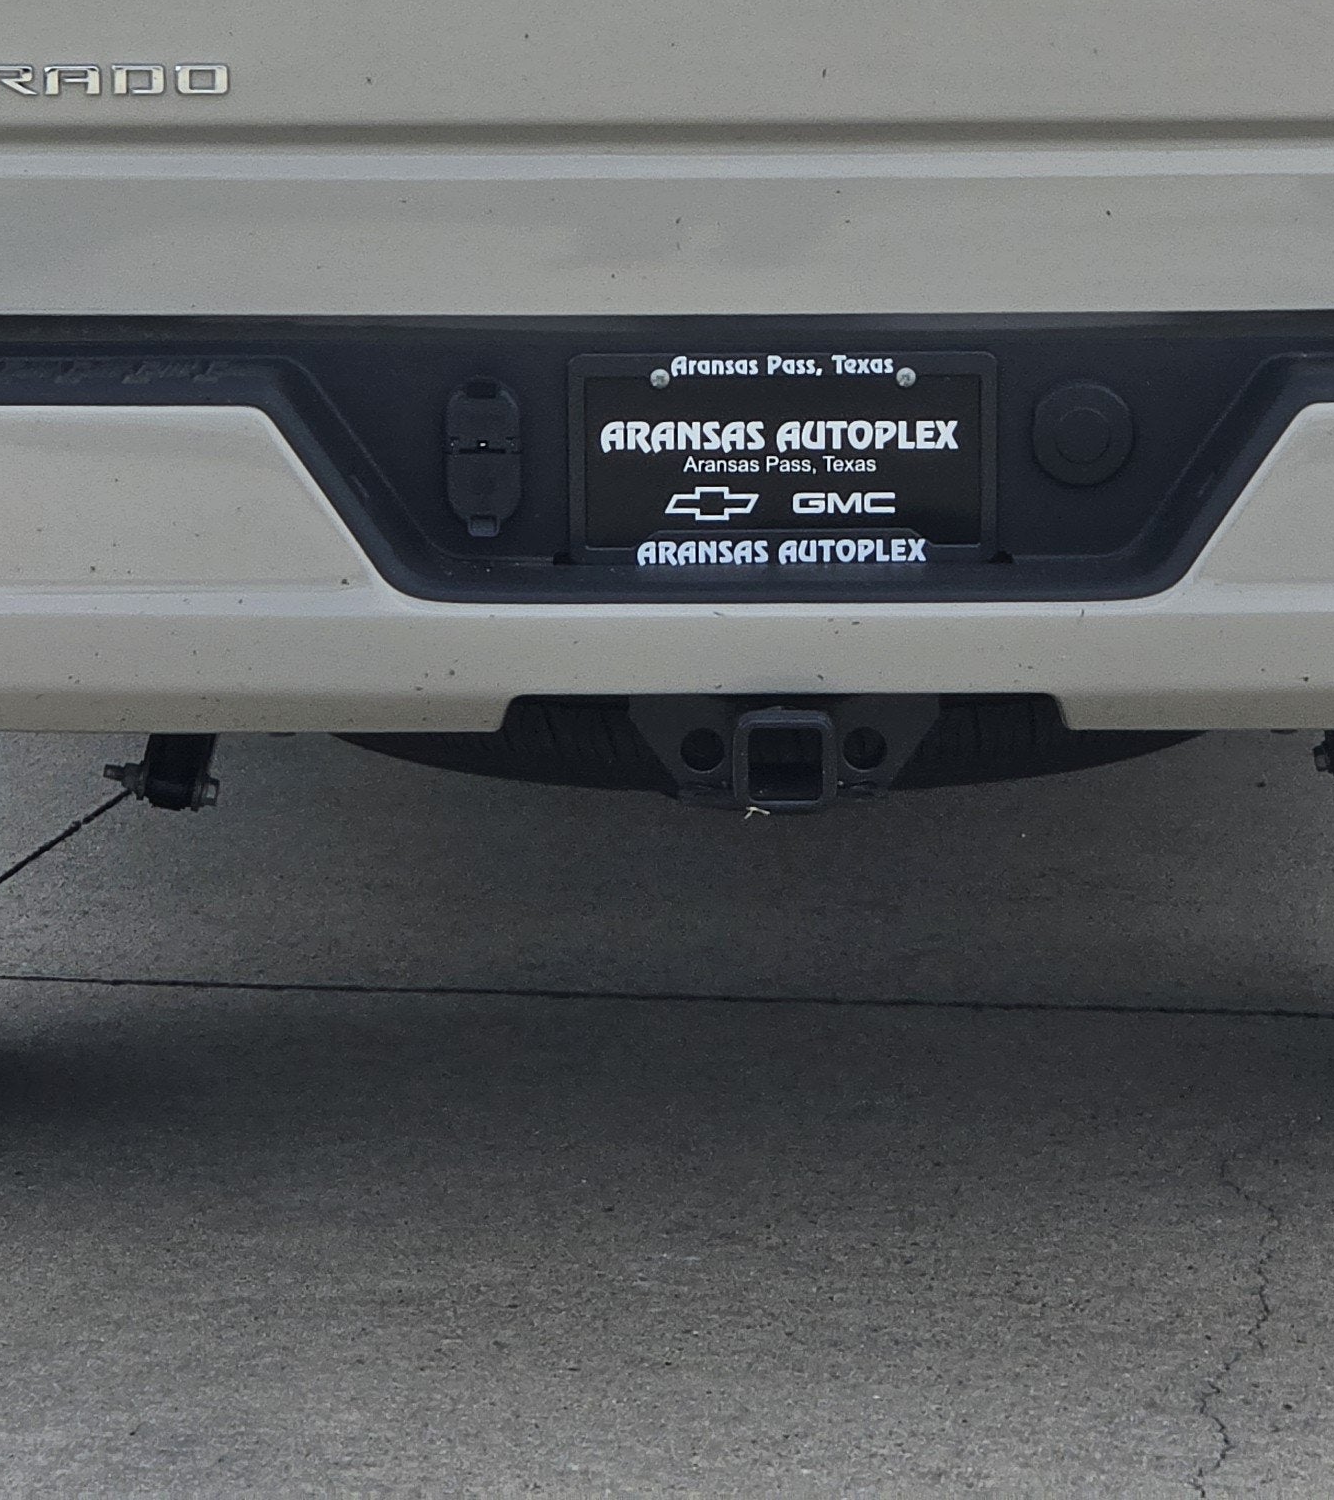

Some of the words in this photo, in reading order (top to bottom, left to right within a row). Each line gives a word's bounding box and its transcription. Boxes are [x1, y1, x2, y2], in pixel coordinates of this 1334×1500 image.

[671, 356, 759, 376] Aransas
[767, 356, 822, 376] Pass,
[832, 354, 893, 374] Texas
[600, 421, 765, 454] ARANSAS
[776, 420, 959, 453] AUTOPLEX
[683, 456, 760, 473] Aransas
[766, 456, 817, 474] Pass,
[823, 456, 877, 472] Texas
[792, 492, 896, 513] GMC
[637, 540, 767, 566] ARANSAS
[778, 538, 927, 565] AUTOPLEX
